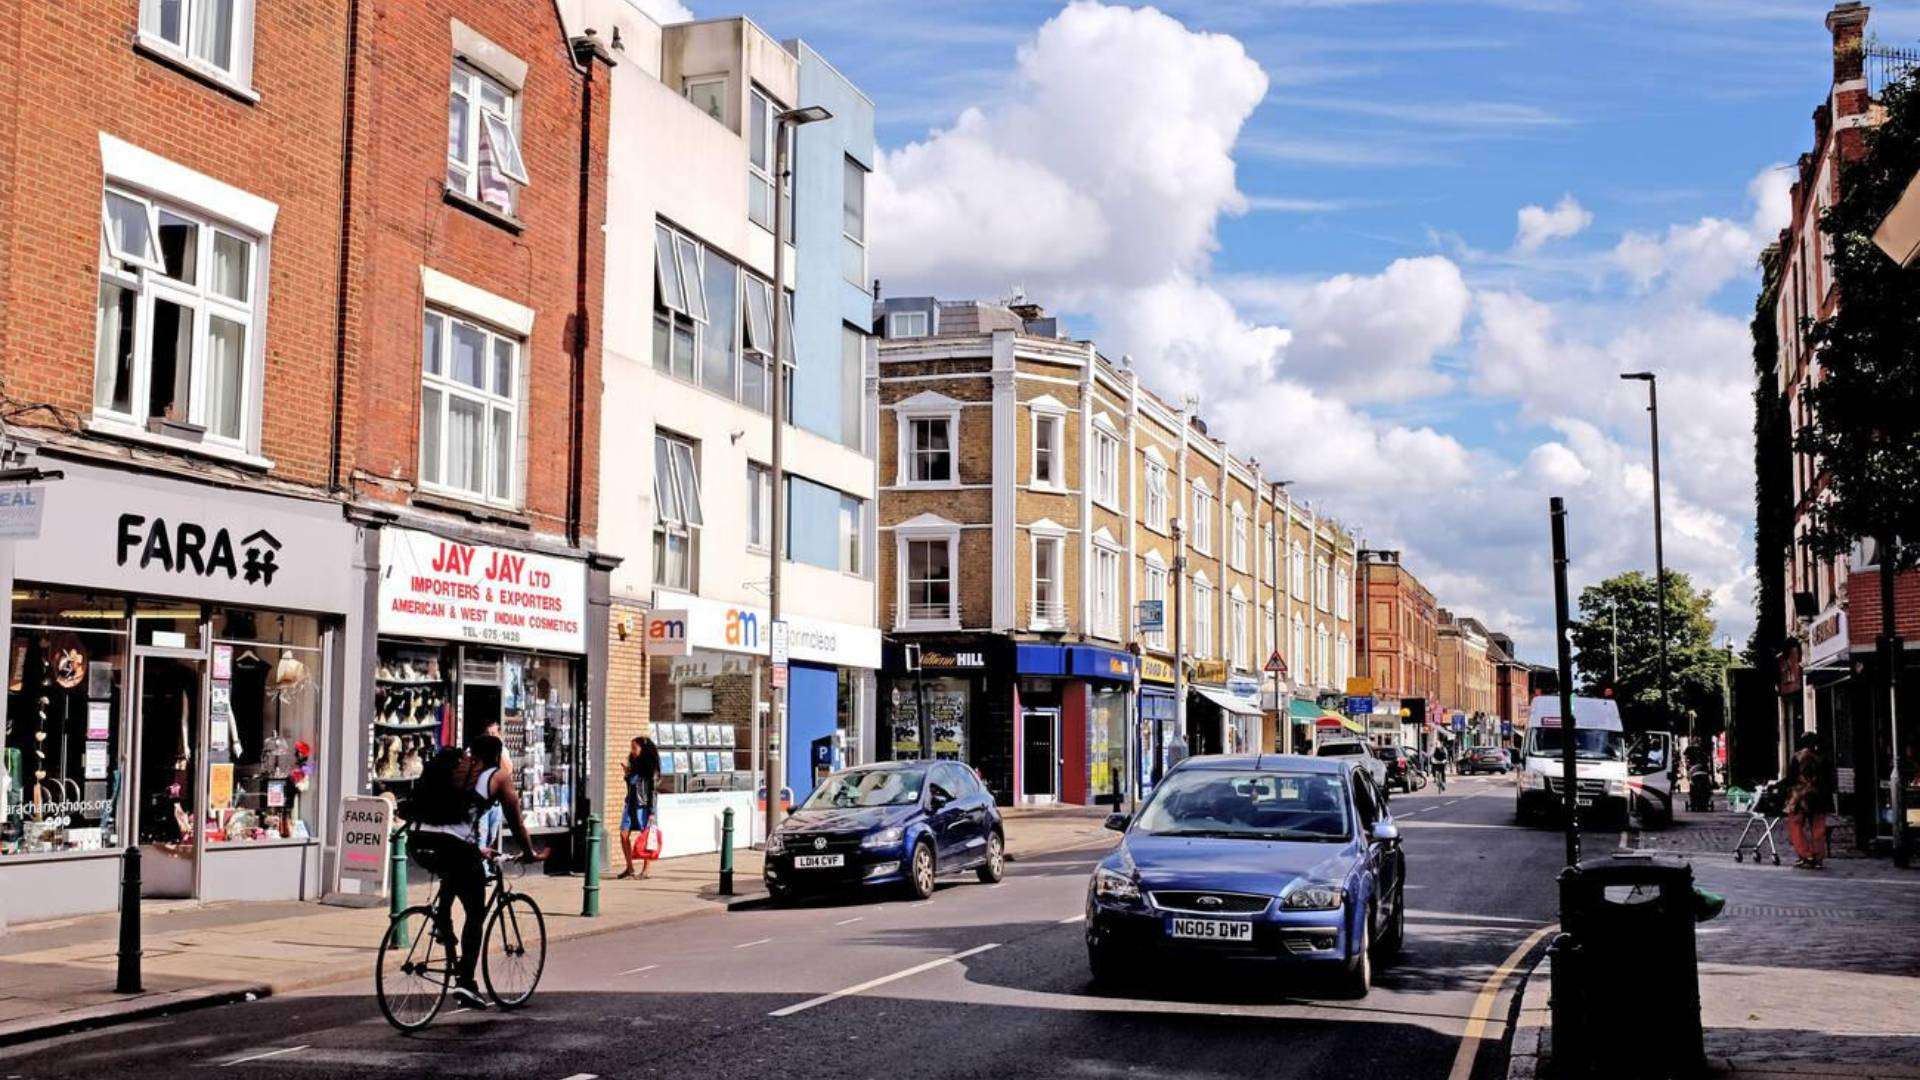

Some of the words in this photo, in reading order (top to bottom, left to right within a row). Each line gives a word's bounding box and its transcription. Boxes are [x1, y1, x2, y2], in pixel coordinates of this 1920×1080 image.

[117, 513, 238, 578] FARA
[432, 543, 475, 576] JAY
[485, 551, 526, 584] JAY
[529, 570, 551, 588] LTD
[411, 576, 480, 601] IMPORTERS
[485, 588, 493, 602] &
[500, 589, 562, 612] EXPORTERS
[391, 598, 445, 618] AMERICAN
[450, 605, 456, 619] &
[460, 607, 488, 622] WEST
[494, 612, 525, 627] INDIAN
[528, 616, 578, 634] COSMETICS
[650, 620, 684, 638] am
[725, 608, 757, 648] am
[957, 653, 985, 666] HILL
[819, 746, 828, 759] P
[345, 811, 373, 823] FARA
[346, 831, 381, 846] OPEN
[1175, 921, 1215, 937] NG05
[1219, 923, 1249, 938] DWP
